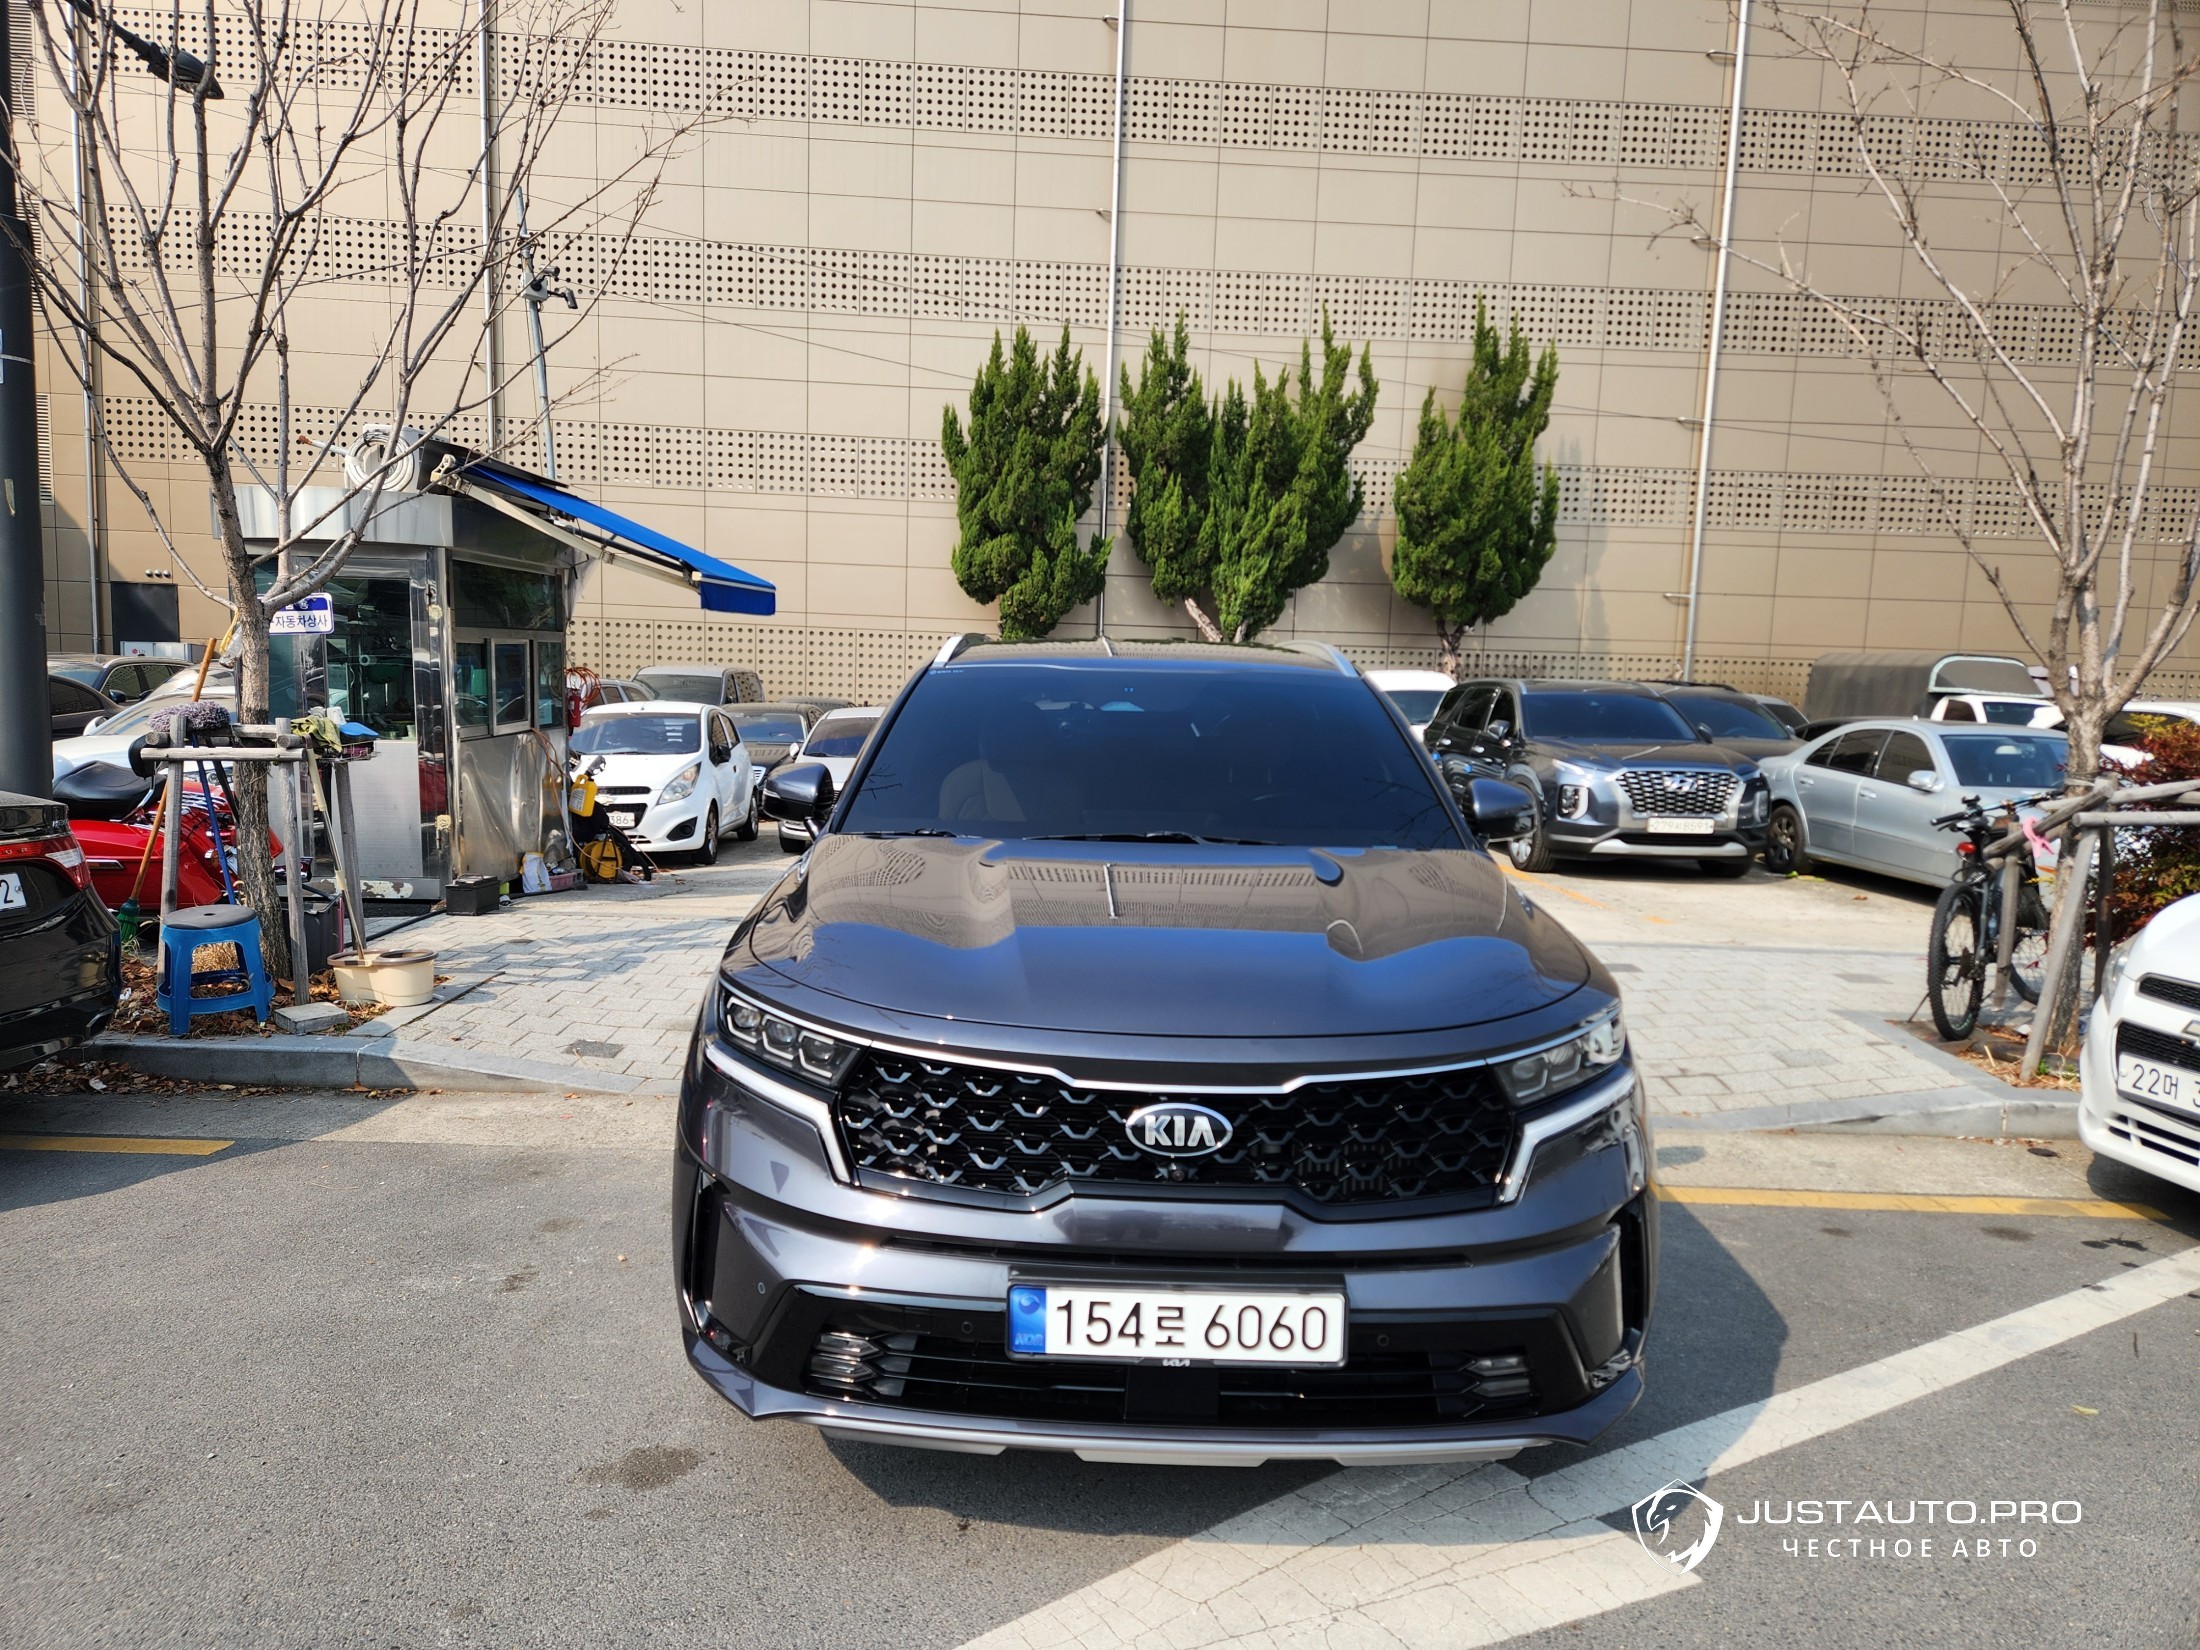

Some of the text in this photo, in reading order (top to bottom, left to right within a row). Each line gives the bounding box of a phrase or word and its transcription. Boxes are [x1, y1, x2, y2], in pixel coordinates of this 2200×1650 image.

[271, 614, 327, 629] 자동차상사
[0, 879, 14, 904] 2
[2132, 1063, 2179, 1100] 22머
[1144, 1114, 1217, 1147] KIA
[1056, 1299, 1327, 1351] 154로 6060
